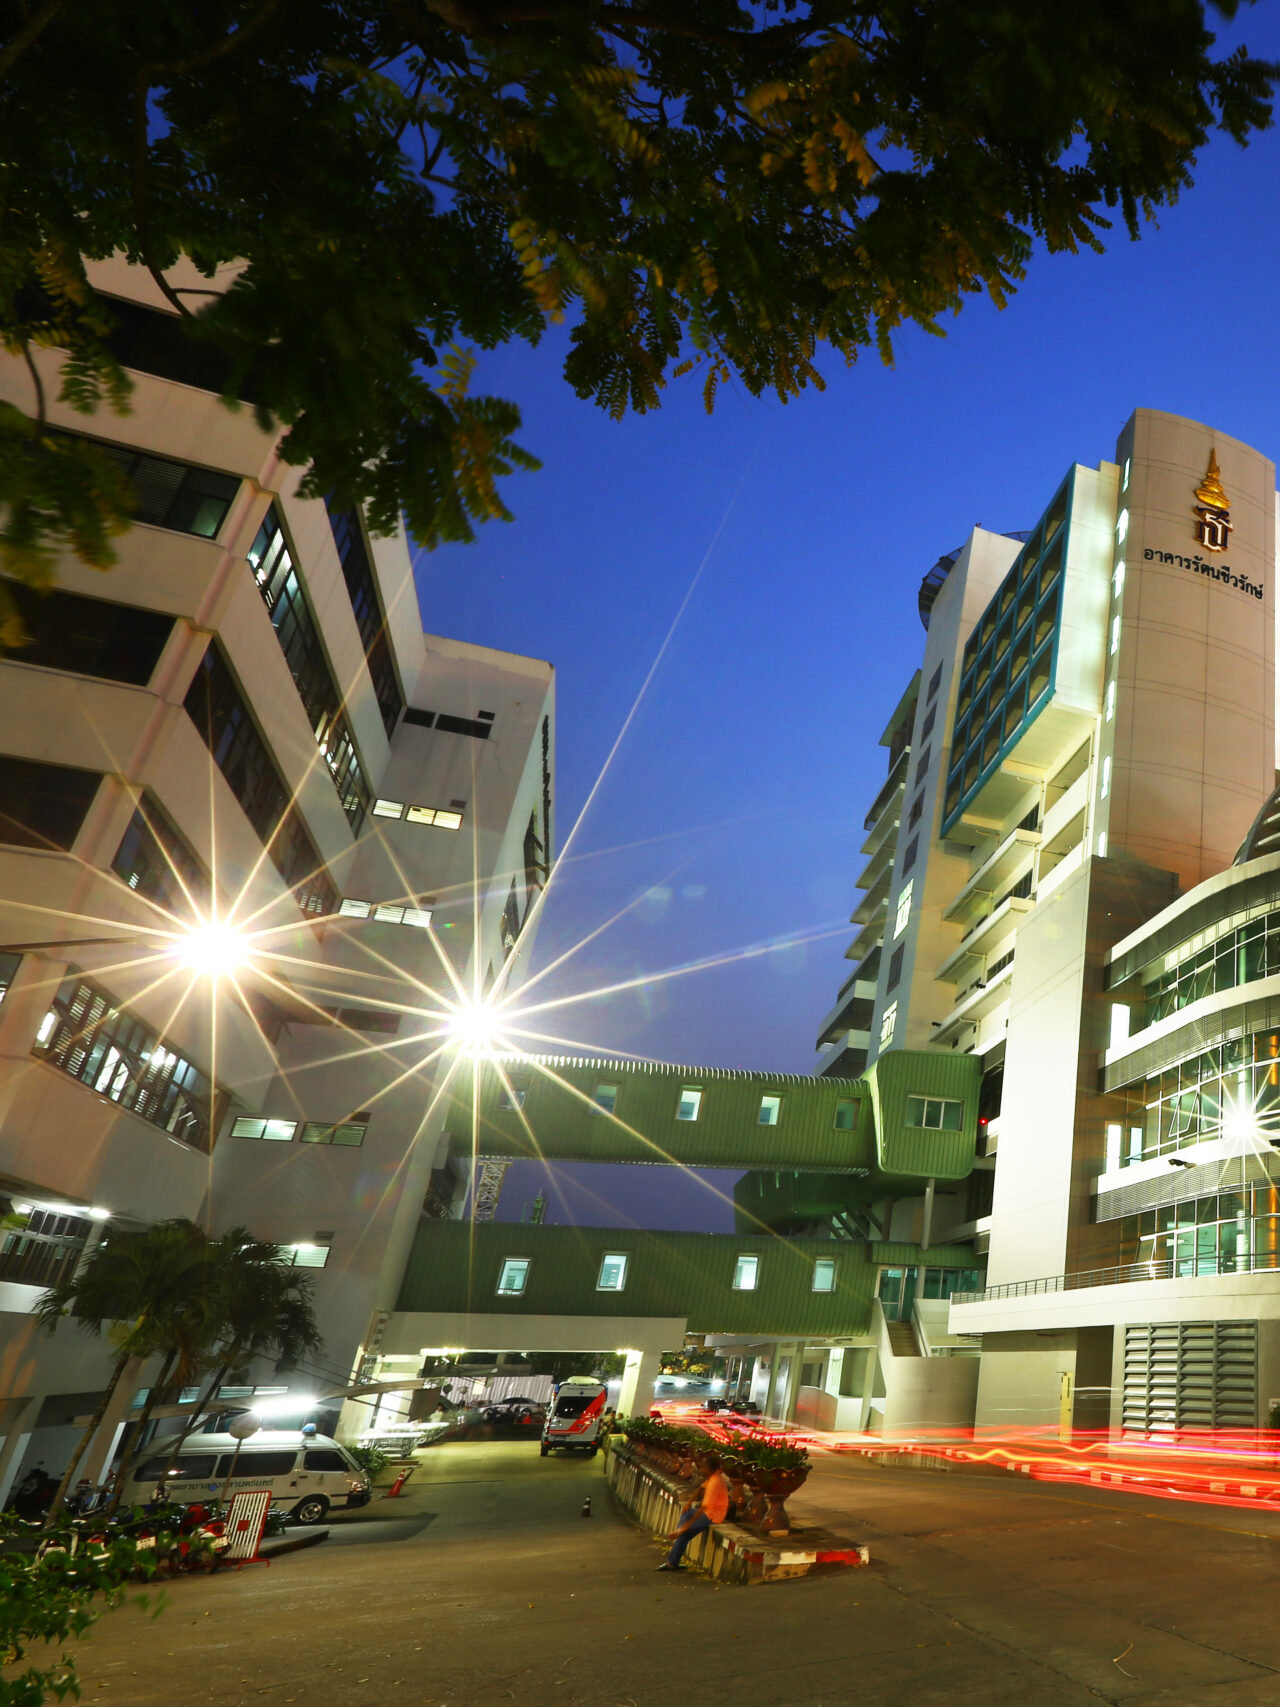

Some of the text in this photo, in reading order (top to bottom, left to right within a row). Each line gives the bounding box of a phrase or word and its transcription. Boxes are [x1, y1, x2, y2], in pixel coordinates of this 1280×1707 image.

[1143, 548, 1264, 600] อาคารรัตนชีวรักษ์
